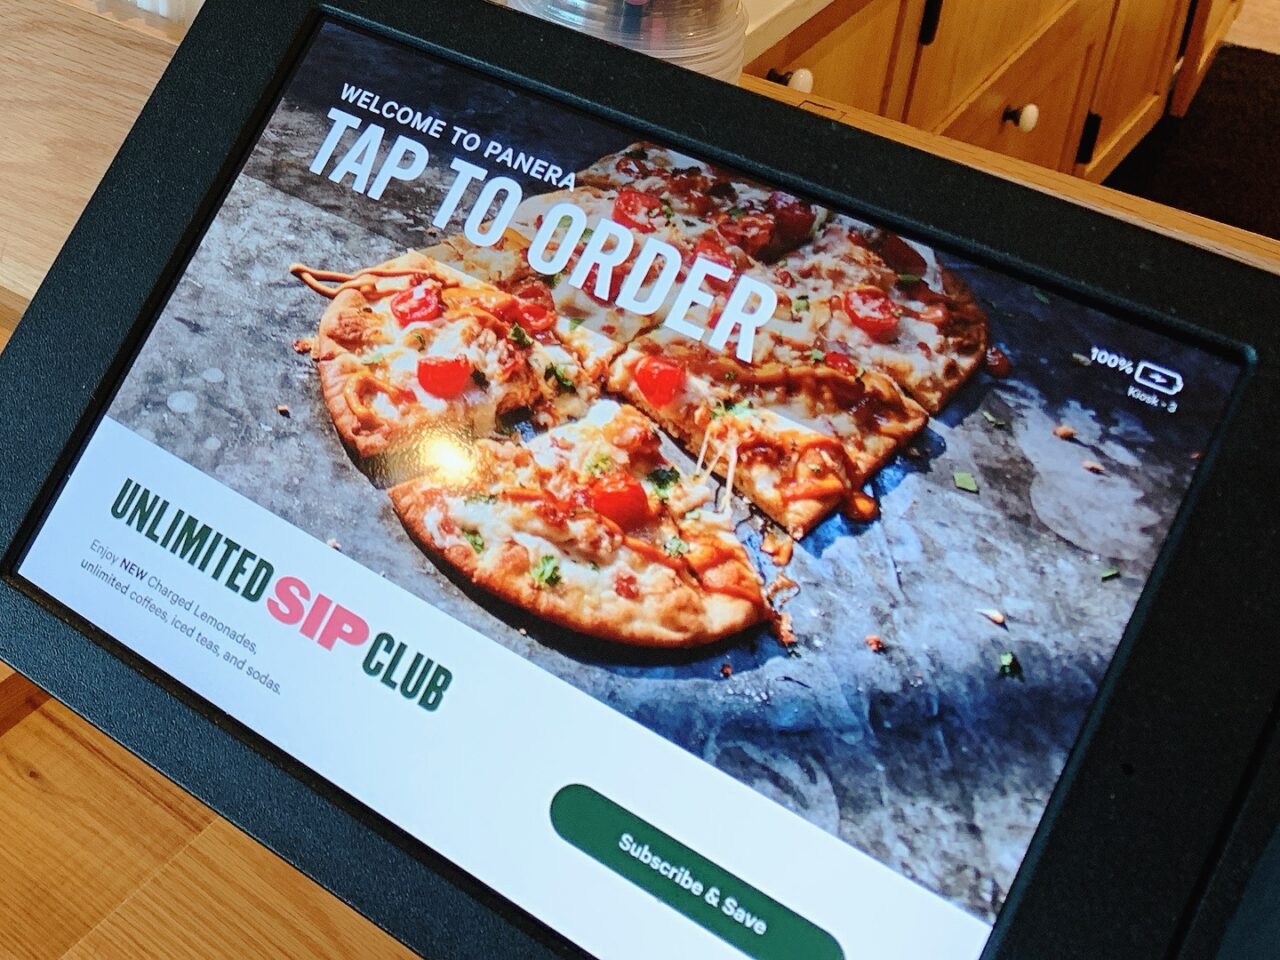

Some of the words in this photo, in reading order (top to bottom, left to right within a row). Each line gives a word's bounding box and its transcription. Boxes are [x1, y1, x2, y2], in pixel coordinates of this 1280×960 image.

[340, 82, 444, 140] WELCOME
[451, 125, 481, 152] TO
[483, 139, 577, 192] PANERA
[307, 107, 430, 202] TAP
[430, 157, 522, 248] TO
[526, 201, 778, 364] ORDER
[1091, 345, 1134, 375] 100%
[1127, 385, 1160, 408] Kiosk
[80, 558, 129, 595] unlimited
[129, 589, 169, 624] coffees,
[171, 615, 196, 638] iced
[195, 633, 220, 658] teas,
[222, 650, 248, 670] and
[246, 665, 281, 696] sodas.
[90, 539, 120, 564] Enjoy
[120, 558, 148, 581] NEW
[147, 575, 194, 611] Charged
[194, 604, 258, 655] Lemonades,
[110, 478, 275, 604] UNLIMITED
[266, 575, 370, 653] SIP
[361, 632, 453, 713] CLUB
[618, 832, 704, 897] Subscribe
[704, 886, 721, 908] &
[721, 896, 768, 935] Save
